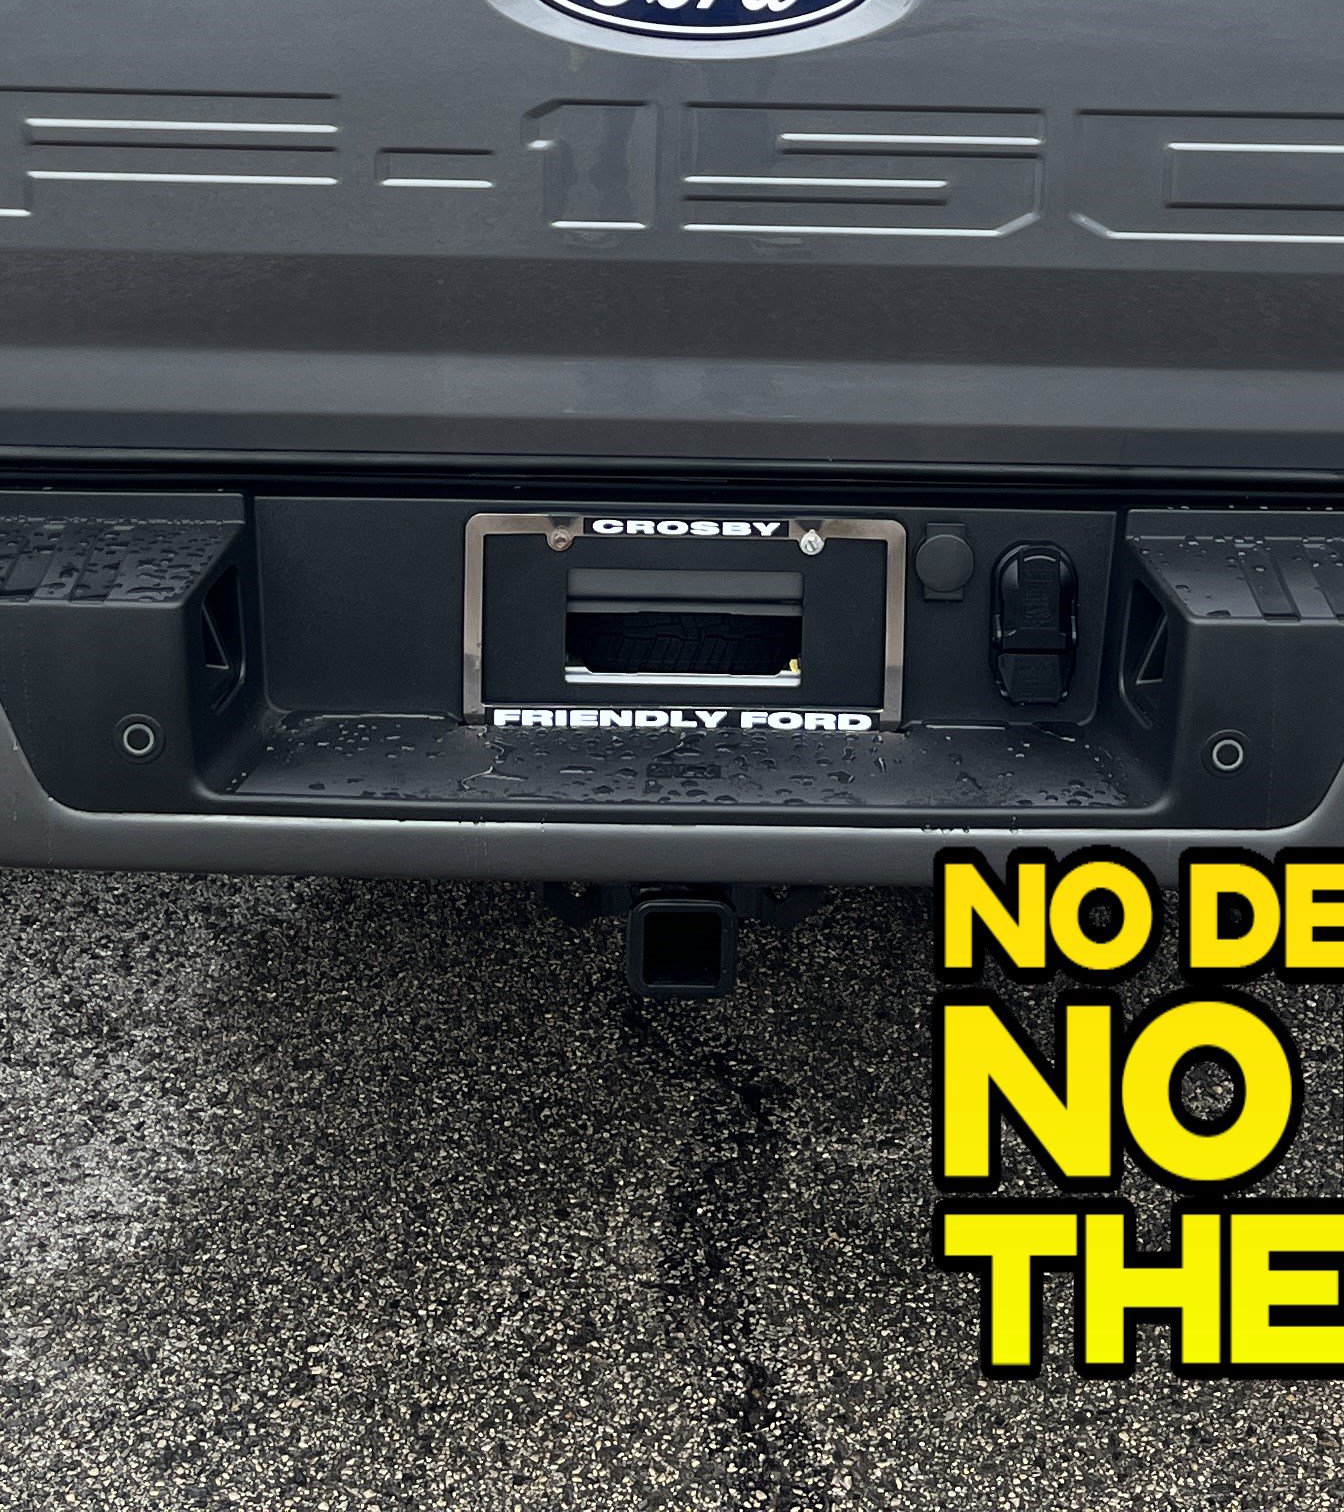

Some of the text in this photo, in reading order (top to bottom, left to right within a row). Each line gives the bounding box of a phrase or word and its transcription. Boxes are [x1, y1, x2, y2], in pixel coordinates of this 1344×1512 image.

[592, 519, 781, 537] CROSBY
[493, 708, 873, 731] FRIENDLY FORD
